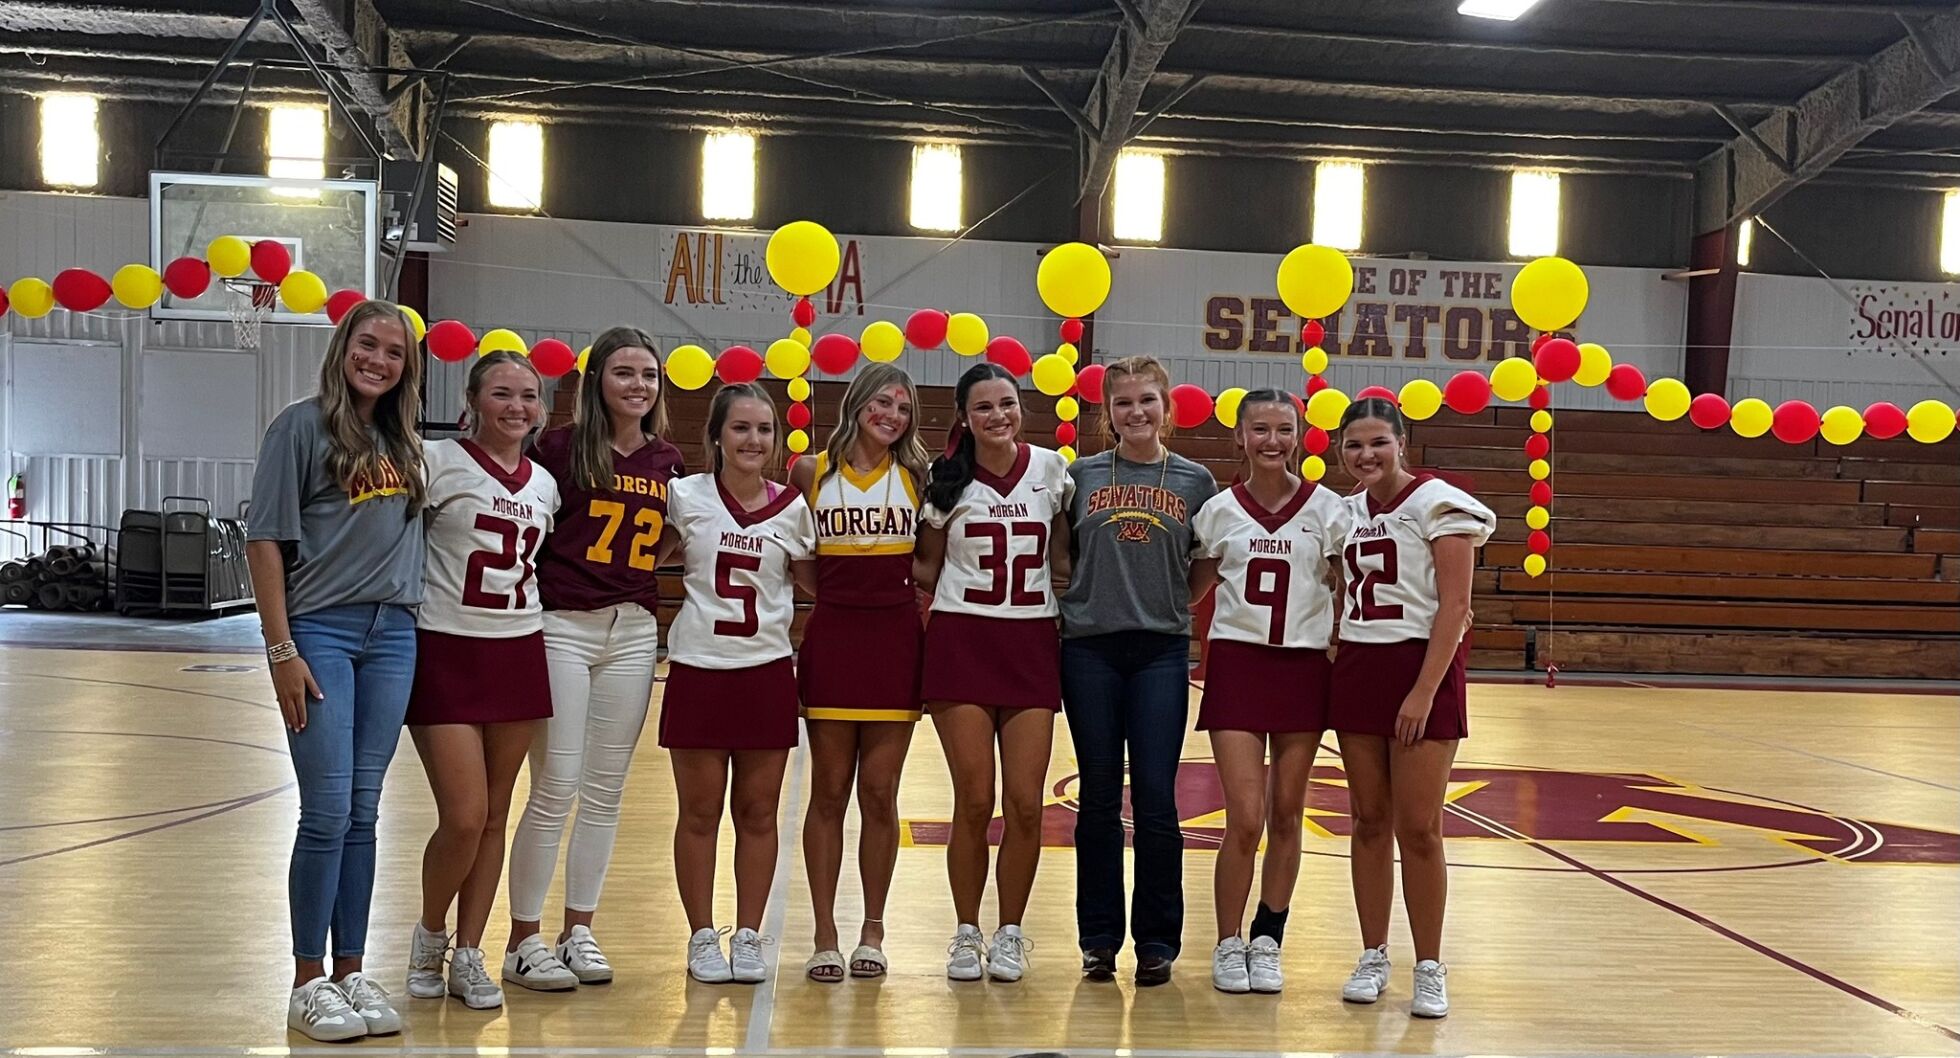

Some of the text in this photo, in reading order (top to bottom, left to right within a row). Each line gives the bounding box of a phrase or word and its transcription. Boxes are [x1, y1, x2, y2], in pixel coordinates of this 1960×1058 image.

[664, 232, 726, 304] All
[733, 253, 762, 285] the
[1389, 269, 1427, 296] OF
[1440, 271, 1503, 299] THE
[1203, 296, 1577, 362] SENATOR
[492, 496, 533, 520] MORGAN
[586, 500, 664, 571] 72
[815, 507, 913, 538] MORGAN
[988, 503, 1029, 518] MORGAN
[1087, 484, 1187, 526] SENATORS
[461, 513, 541, 610] 21
[720, 531, 763, 554] MORGAN
[963, 521, 1047, 607] 32
[1249, 539, 1292, 554] MORGAN
[713, 551, 762, 638] 5
[1244, 558, 1291, 645] 9
[1343, 538, 1404, 621] 12
